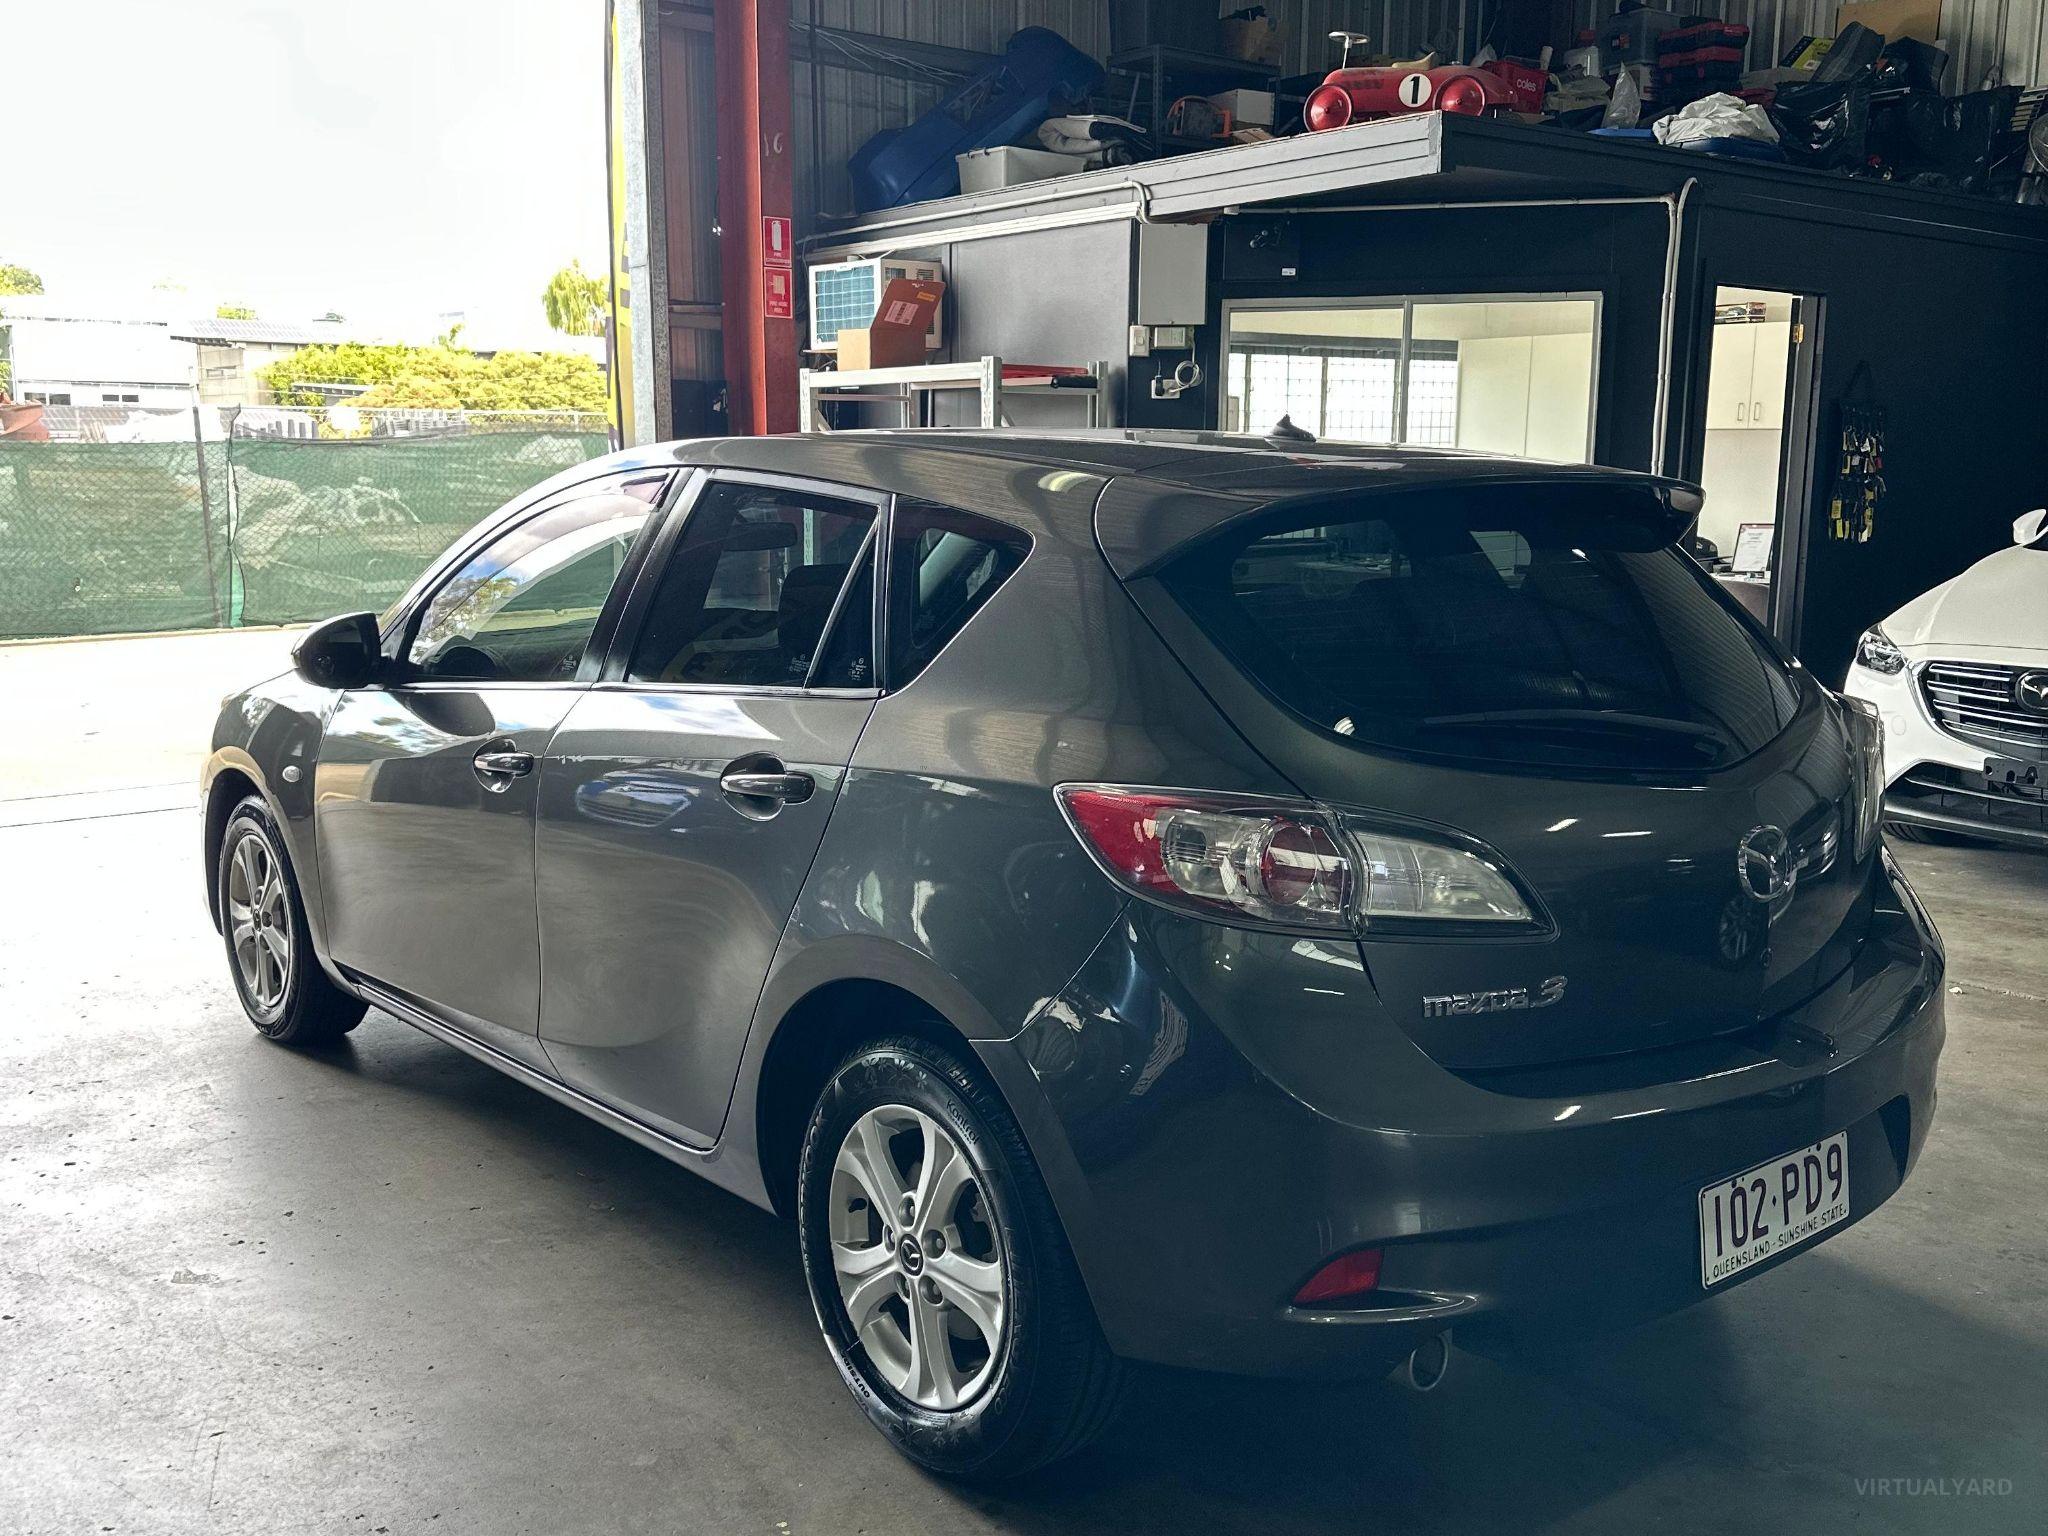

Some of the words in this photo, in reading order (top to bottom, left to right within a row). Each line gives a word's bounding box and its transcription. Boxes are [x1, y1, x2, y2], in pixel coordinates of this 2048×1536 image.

[1409, 75, 1421, 104] 1
[1516, 78, 1537, 92] coles
[1713, 1240, 1771, 1278] QUEENSLAND
[1778, 1216, 1818, 1247] SUNSHINE
[1821, 1203, 1845, 1226] STATE
